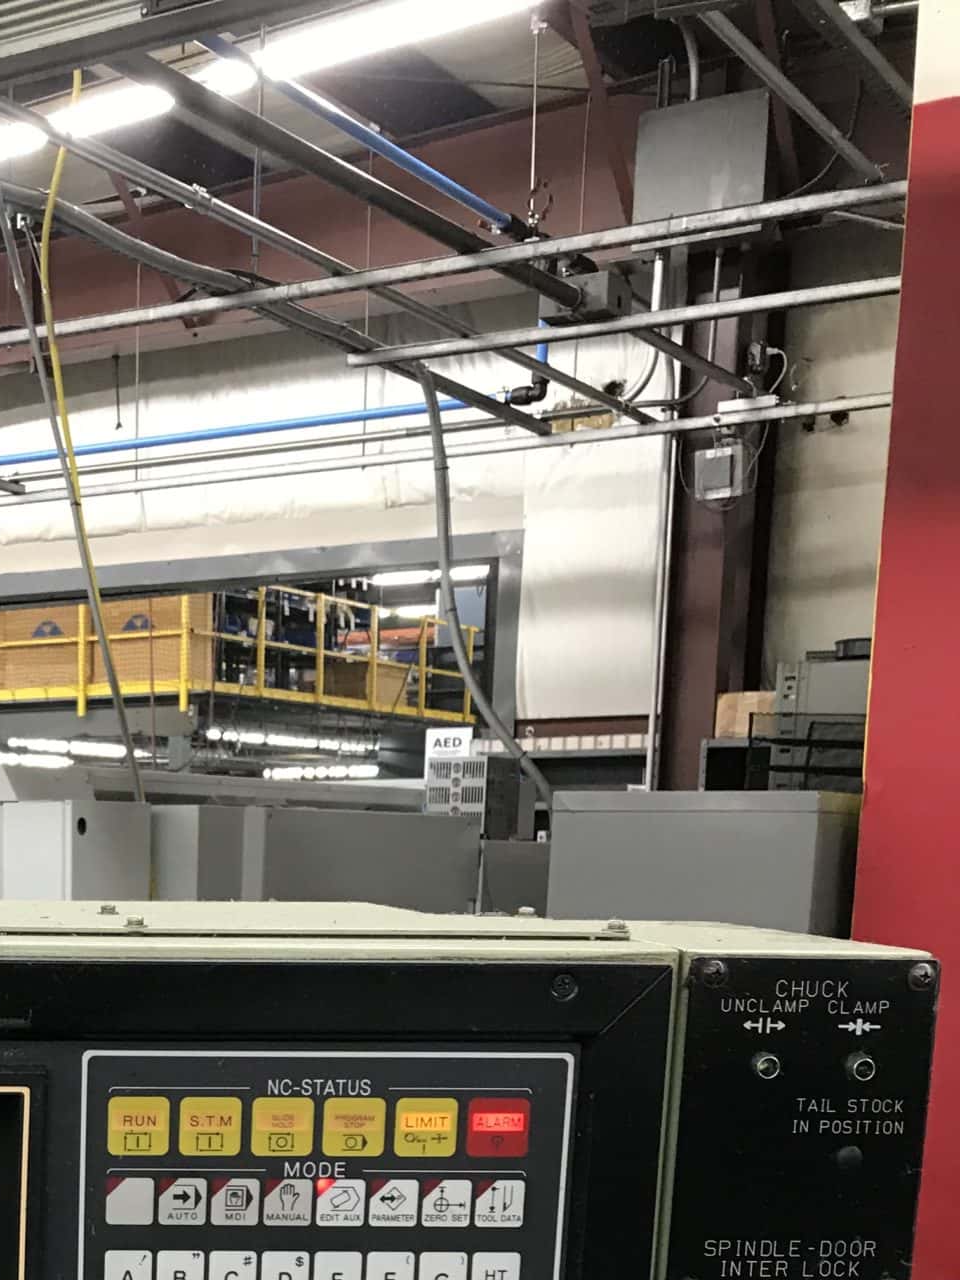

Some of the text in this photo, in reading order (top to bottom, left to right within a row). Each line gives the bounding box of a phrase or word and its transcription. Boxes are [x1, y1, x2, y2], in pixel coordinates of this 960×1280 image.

[432, 736, 462, 749] AED
[775, 979, 849, 998] CHUCK
[721, 998, 890, 1015] UNCLAMP CLAMP
[267, 1079, 372, 1097] NC-STATUS
[796, 1097, 904, 1113] TAIL STOCK
[122, 1115, 157, 1127] RUN
[405, 1116, 449, 1128] LIMIT
[476, 1116, 522, 1127] ALARM
[792, 1119, 904, 1135] IN POSITION
[284, 1162, 346, 1178] MODE
[167, 1212, 198, 1221] AUTO
[225, 1212, 246, 1221] MDI
[266, 1213, 308, 1222] MANUAL
[320, 1214, 361, 1222] EDIT AUX
[371, 1214, 415, 1223] PARAMETER
[721, 1260, 860, 1278] INTER LOCK
